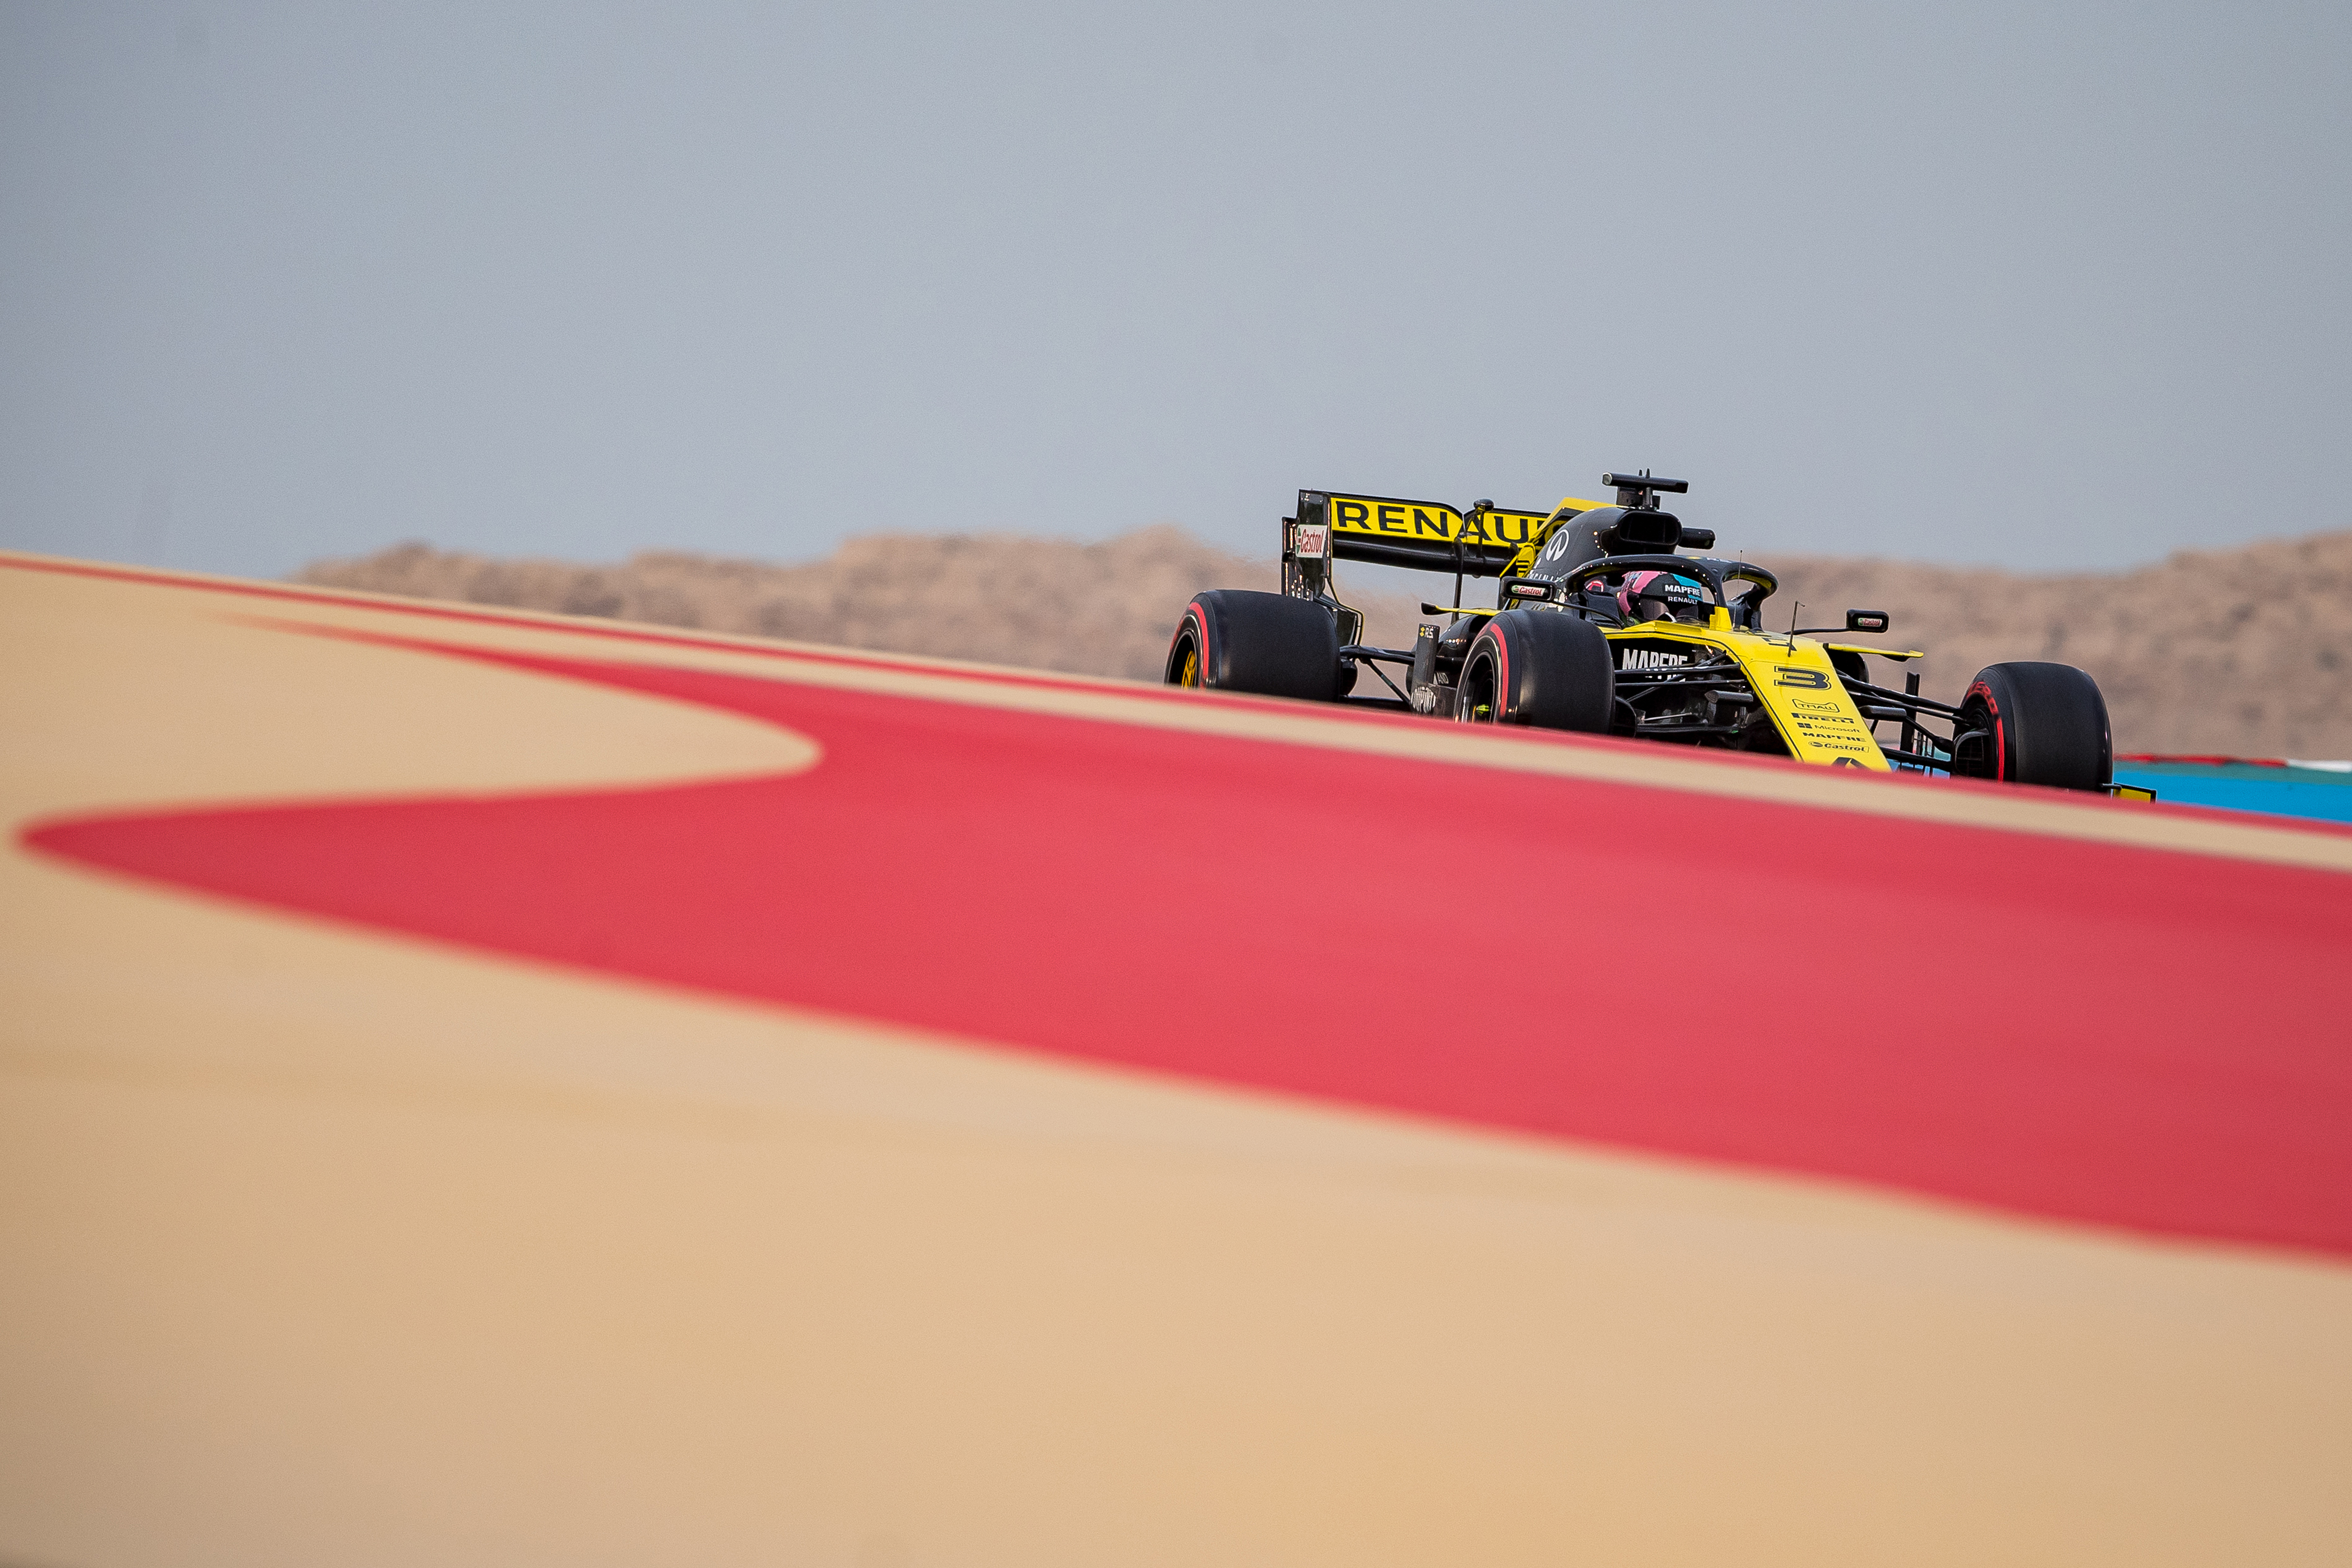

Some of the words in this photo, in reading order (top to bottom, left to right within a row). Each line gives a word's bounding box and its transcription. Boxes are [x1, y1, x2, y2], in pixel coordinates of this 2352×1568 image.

[1336, 501, 1546, 544] RENAU
[1301, 528, 1324, 553] Castrol
[1519, 586, 1542, 596] Castrol
[1665, 584, 1700, 596] MAPFRE
[1668, 596, 1698, 605] RENAULT
[1774, 666, 1831, 690] 3
[1791, 712, 1854, 724] PIRELLI
[1814, 725, 1861, 733] Microsoft
[1803, 732, 1866, 742] MAPFRE
[1824, 743, 1865, 752] Castrol
